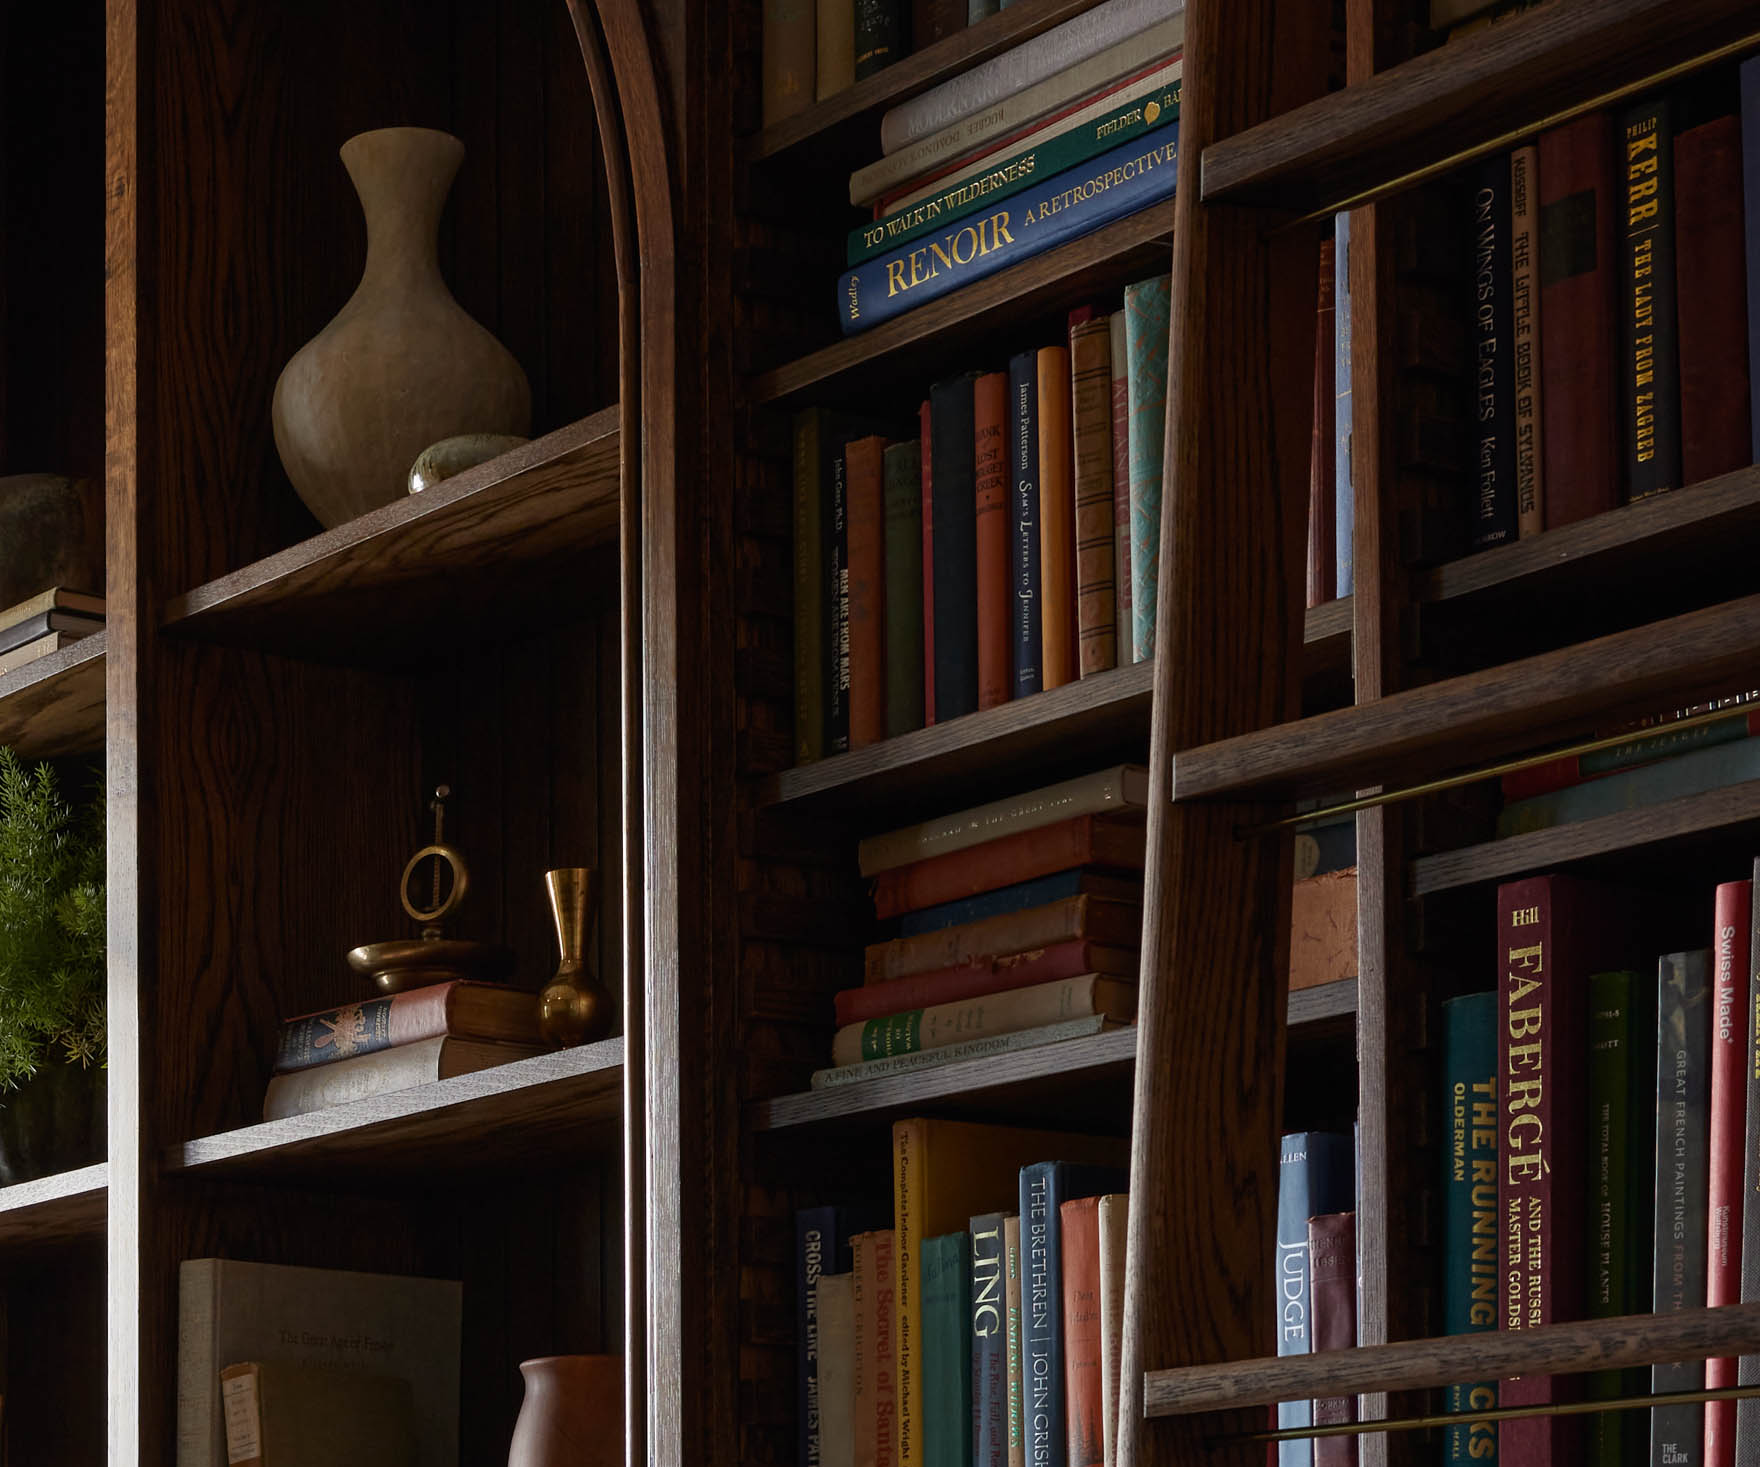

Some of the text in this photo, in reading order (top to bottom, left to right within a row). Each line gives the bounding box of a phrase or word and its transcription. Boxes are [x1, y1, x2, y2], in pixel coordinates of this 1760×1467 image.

[864, 153, 1037, 249] TO WALK IN WILDERNESS
[886, 210, 1015, 297] RENOIR
[1025, 210, 1037, 227] A
[1039, 141, 1178, 221] RETROSPECTIVE
[1627, 132, 1659, 226] KERR
[849, 275, 860, 320] Wadley
[1475, 187, 1496, 422] ON WINGS OF EAGLES
[1515, 231, 1536, 513] THE LITTLE BOOK OF SYLVANUS
[1633, 238, 1655, 463] THE LADY FROM ZAGREB
[1018, 382, 1033, 470] James Patterson
[1479, 436, 1496, 521] Ken Follett
[839, 568, 850, 691] MEN ARE FROM MARS
[1511, 906, 1540, 927] Hill
[1719, 926, 1735, 982] Swiss
[953, 1037, 1010, 1057] KINGDOM
[1507, 940, 1551, 1185] FABERGÉ
[1454, 1082, 1465, 1182] OLDERMAN
[1674, 1049, 1688, 1240] GREAT FRENCH PAINTINGS
[900, 1156, 909, 1307] Complete Gardener
[1471, 1074, 1497, 1326] THE RUNNING
[1528, 1196, 1541, 1270] AND THE
[806, 1230, 822, 1285] CROSS
[875, 1237, 894, 1274] The
[973, 1226, 1001, 1339] LING
[1030, 1177, 1048, 1329] THE BRETHREN
[1278, 1241, 1309, 1342] JUDGE
[1599, 1202, 1612, 1304] HOUSE PLANTS
[1672, 1244, 1685, 1287] FROM
[875, 1287, 894, 1364] Secret
[900, 1314, 910, 1417] edited by Michael
[875, 1370, 894, 1394] of
[1009, 1380, 1021, 1448] WIDOWS
[1032, 1352, 1050, 1409] JOHN
[1661, 1454, 1690, 1464] CLARK
[1662, 1443, 1678, 1454] THE
